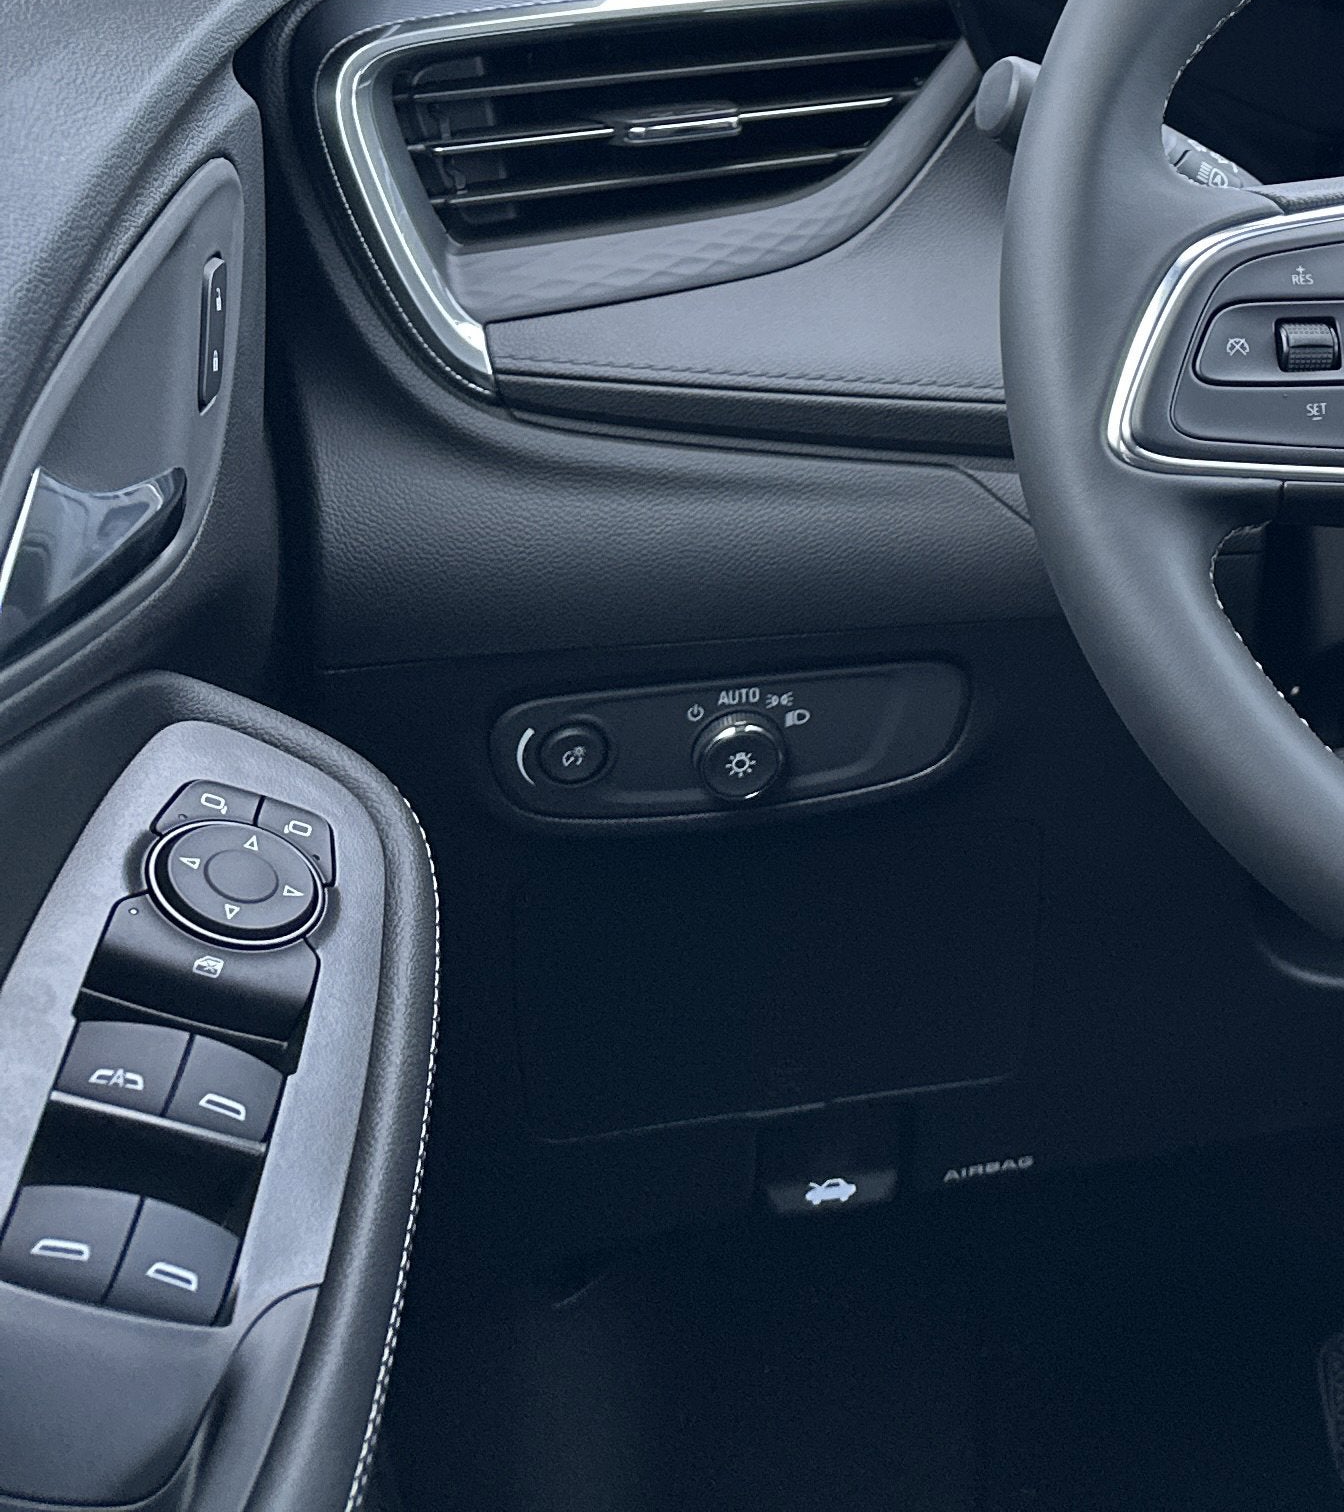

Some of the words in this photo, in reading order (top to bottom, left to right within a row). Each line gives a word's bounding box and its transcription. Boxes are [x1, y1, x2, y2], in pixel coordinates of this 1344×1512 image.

[1291, 274, 1314, 286] RES
[1306, 402, 1327, 416] SET
[718, 687, 760, 706] AUTO
[944, 1155, 1034, 1183] AIRBAG
